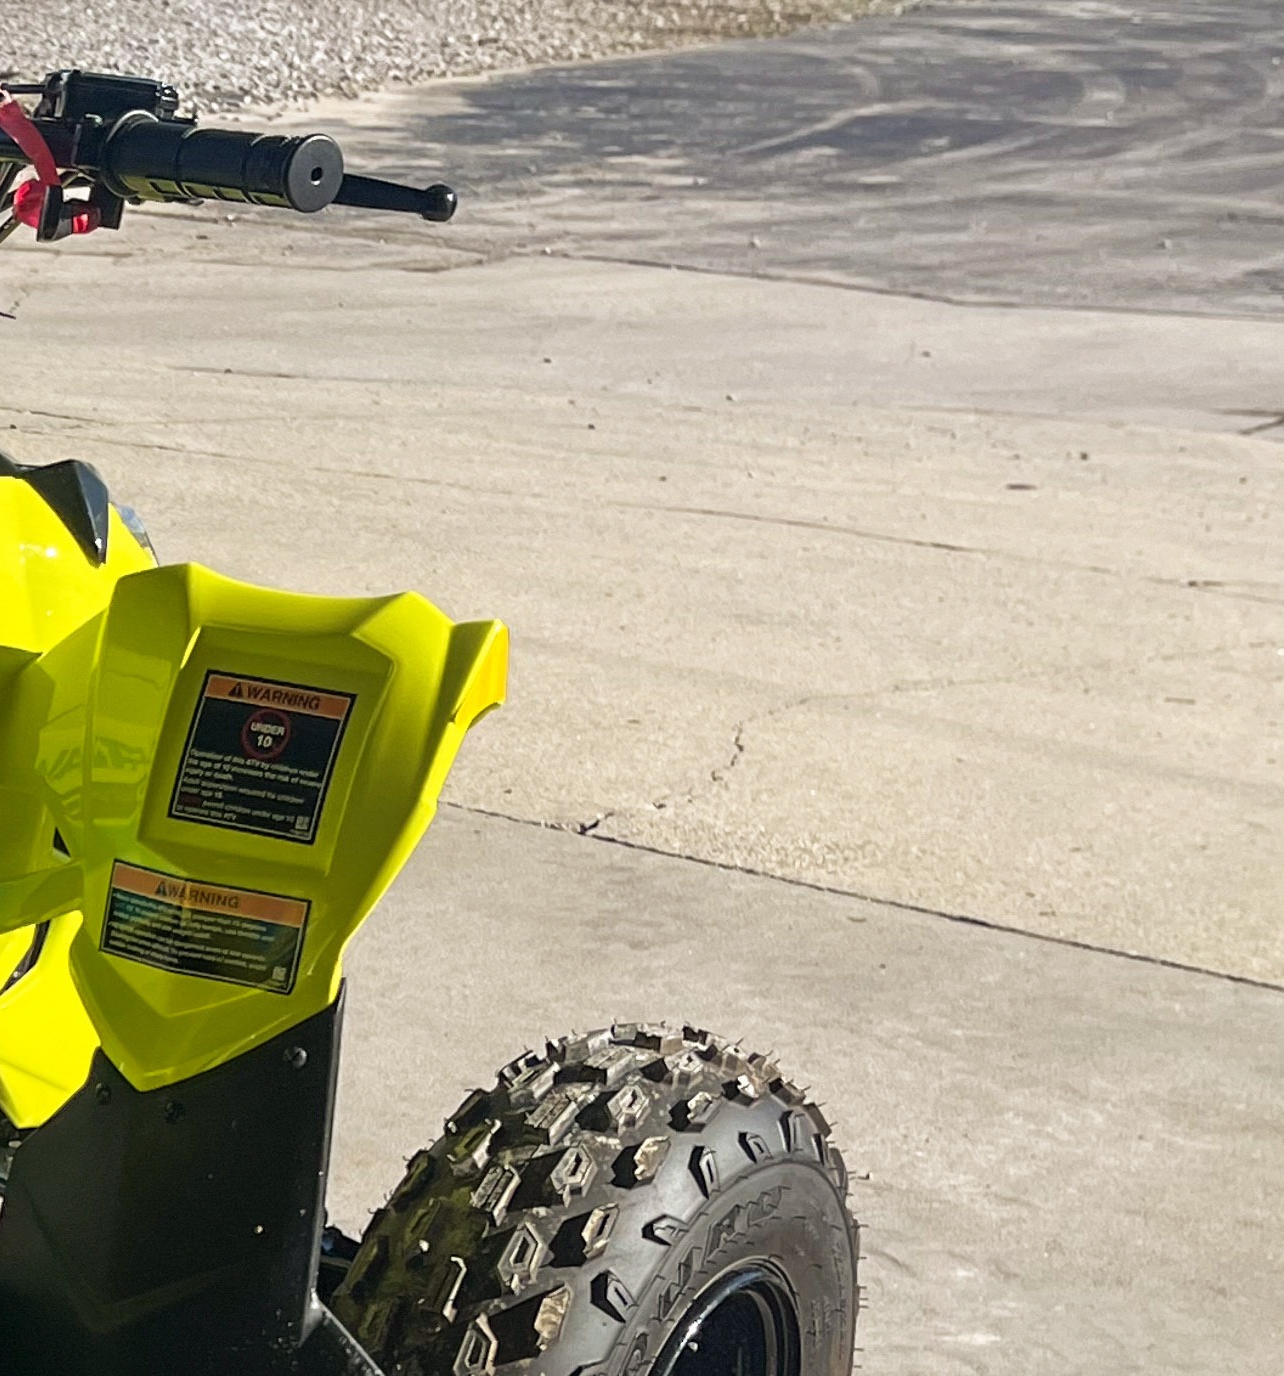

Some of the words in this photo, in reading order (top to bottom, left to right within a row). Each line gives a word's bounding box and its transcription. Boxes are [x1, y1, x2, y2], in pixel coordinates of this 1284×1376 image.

[248, 686, 321, 711] WARNING
[257, 735, 273, 748] 10
[169, 883, 240, 908] WARNING
